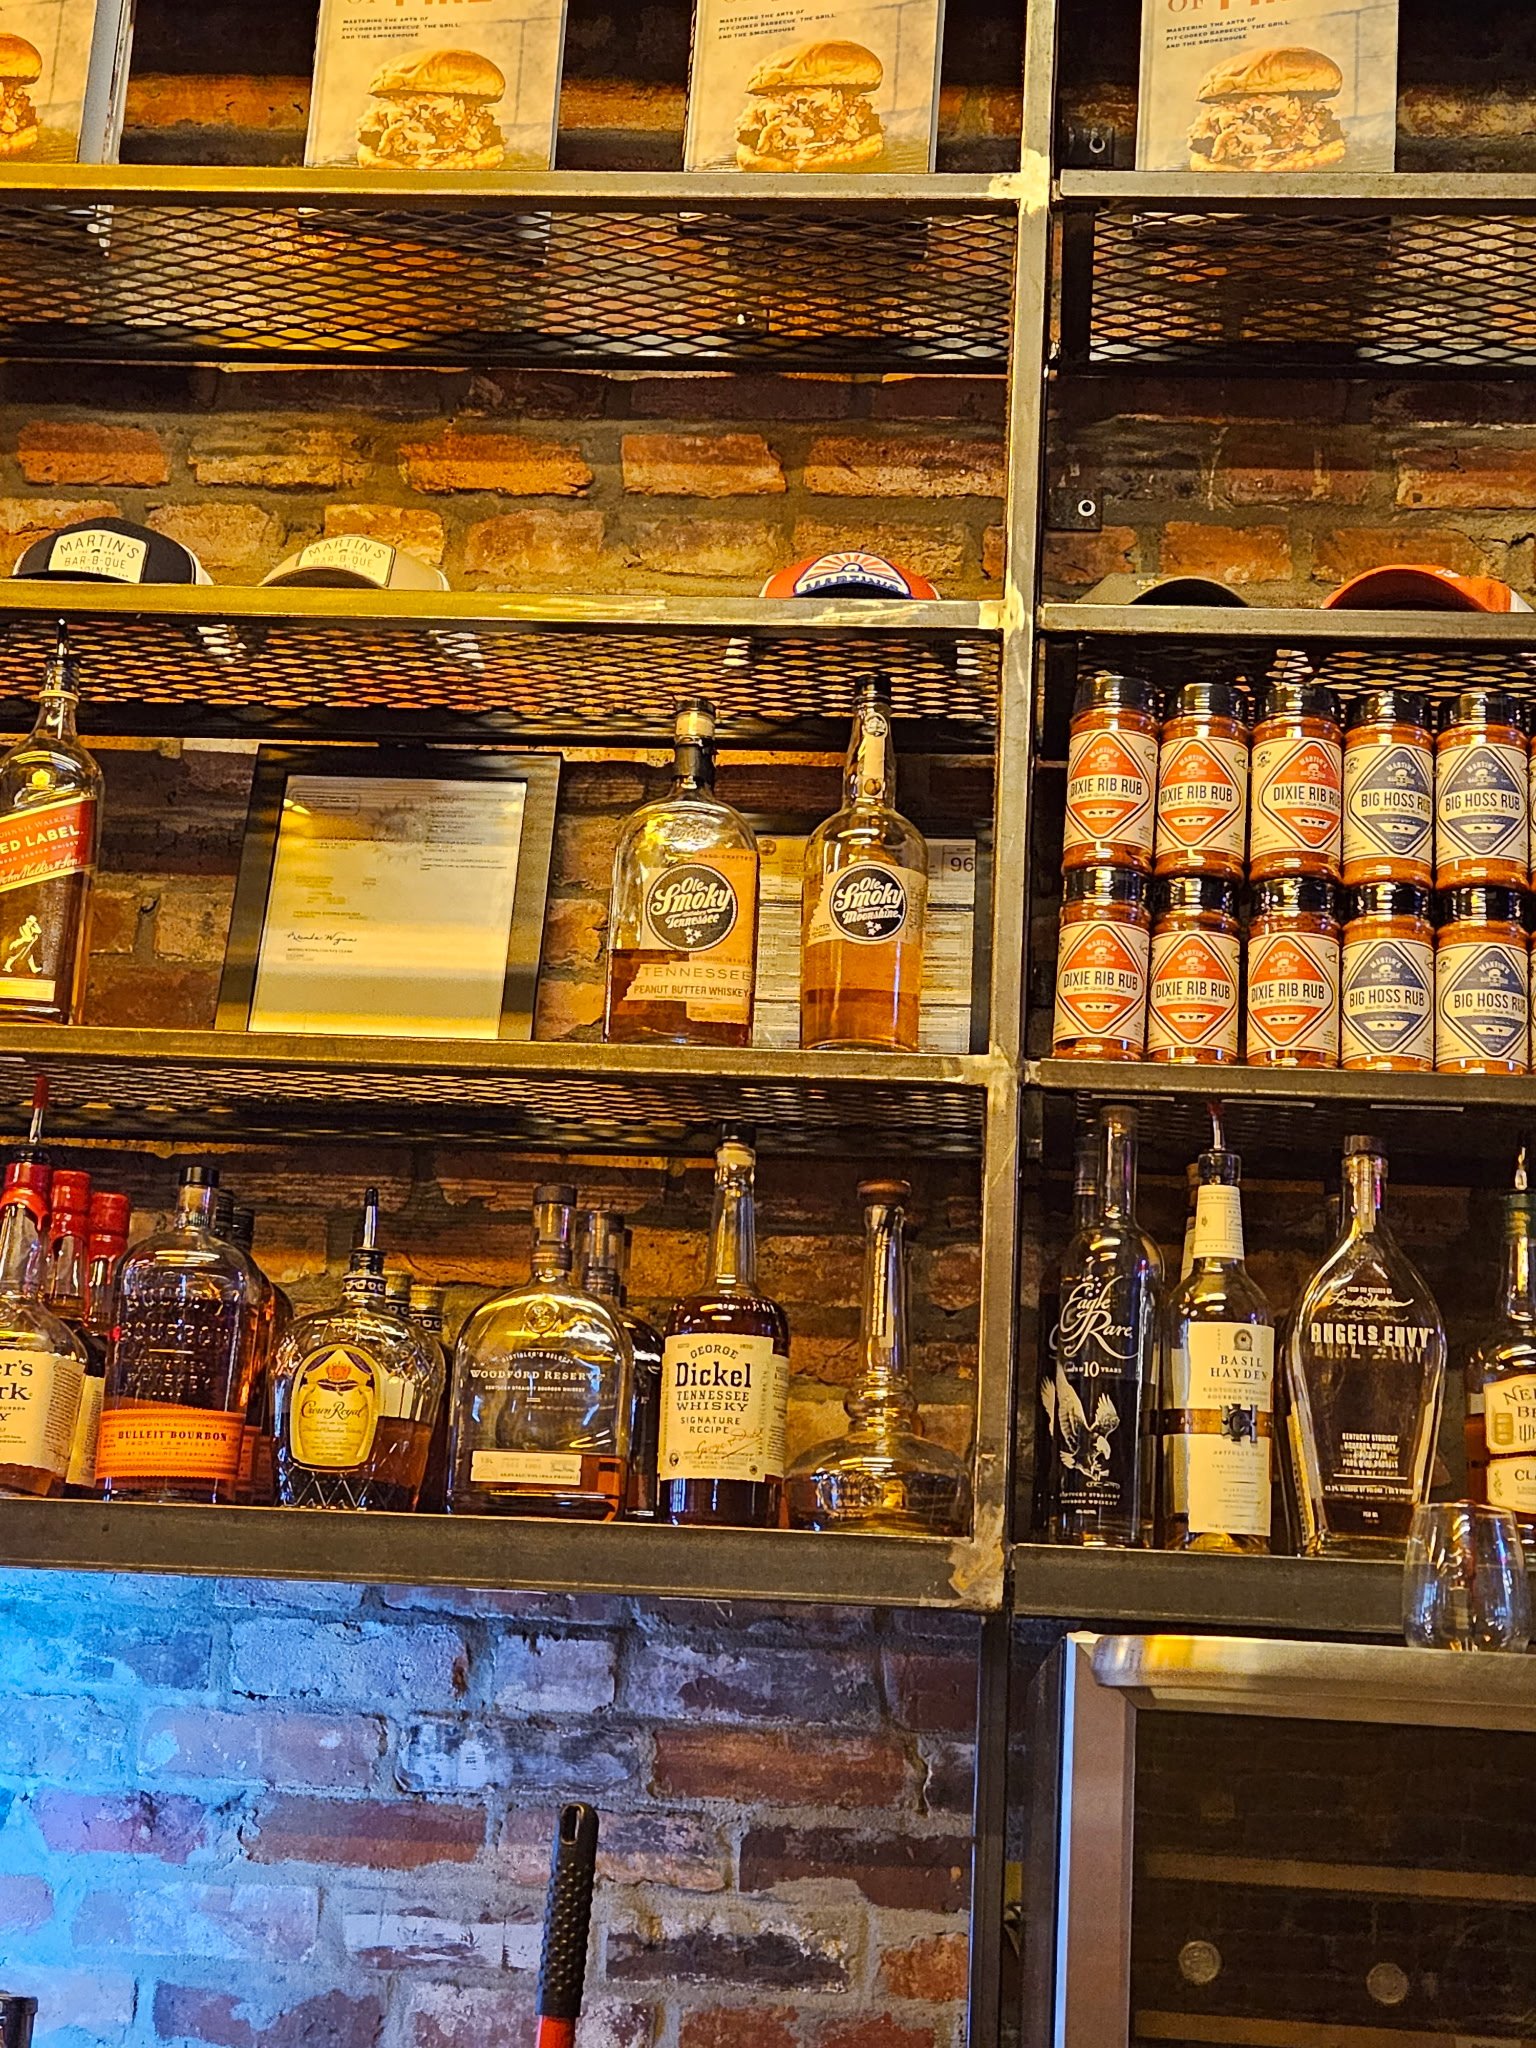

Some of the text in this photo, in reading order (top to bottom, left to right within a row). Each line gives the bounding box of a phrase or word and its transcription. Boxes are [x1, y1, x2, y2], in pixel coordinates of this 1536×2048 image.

[60, 534, 140, 559] MARTIN'S
[64, 556, 126, 569] BAR-B-QUE
[1386, 762, 1417, 774] MARTIN'S
[1466, 760, 1499, 773] MARTIN'S
[1070, 778, 1142, 797] DIXIE RIB RUB
[1161, 785, 1232, 805] DIXIE RIB RUB
[1274, 785, 1305, 801] DIXIE
[1309, 787, 1326, 802] RIB
[1362, 792, 1380, 807] BIG
[1384, 792, 1414, 808] HOSS
[1446, 792, 1520, 812] BIG HOSS RUB
[25, 824, 80, 848] LABEL
[950, 857, 974, 872] 96
[682, 877, 708, 893] Ole
[860, 877, 884, 890] Ole
[651, 883, 733, 916] Smoky
[834, 883, 904, 911] Smoky
[665, 914, 719, 928] Tennessee
[843, 908, 902, 924] Moonshine
[1370, 957, 1402, 968] MARTIN'S
[1479, 960, 1510, 974] MARTIN'S
[643, 967, 752, 982] TENNESSEE
[1064, 971, 1137, 990] DIXIE RIB RUB
[634, 985, 668, 994] PEANUT
[672, 986, 706, 994] BUTTER
[709, 986, 748, 998] WHISKEY
[1156, 981, 1230, 1000] DIXIE RIB RUB
[1252, 982, 1324, 1002] DIXIE RIB RUB
[1350, 989, 1424, 1007] BIG HOSS RUB
[1454, 993, 1472, 1008] BIG
[1477, 993, 1508, 1008] HOSS
[1060, 1275, 1123, 1341] Eagle
[1064, 1310, 1139, 1359] Rare
[1384, 1326, 1428, 1348] ENVY
[690, 1344, 739, 1360] GEORGE
[1083, 1361, 1099, 1377] 10
[1221, 1355, 1263, 1367] BASIL
[470, 1370, 603, 1381] WOODFORD RESERVE
[675, 1361, 751, 1388] Dickel
[1210, 1368, 1268, 1380] HAYDEN
[677, 1390, 749, 1402] TENNESSEE
[301, 1400, 368, 1420] Crown Royal
[677, 1402, 748, 1412] WHISKY
[680, 1416, 740, 1425] SIGNATURE
[118, 1430, 227, 1441] BULLEIT BOURBON
[690, 1426, 729, 1434] RECIPE
